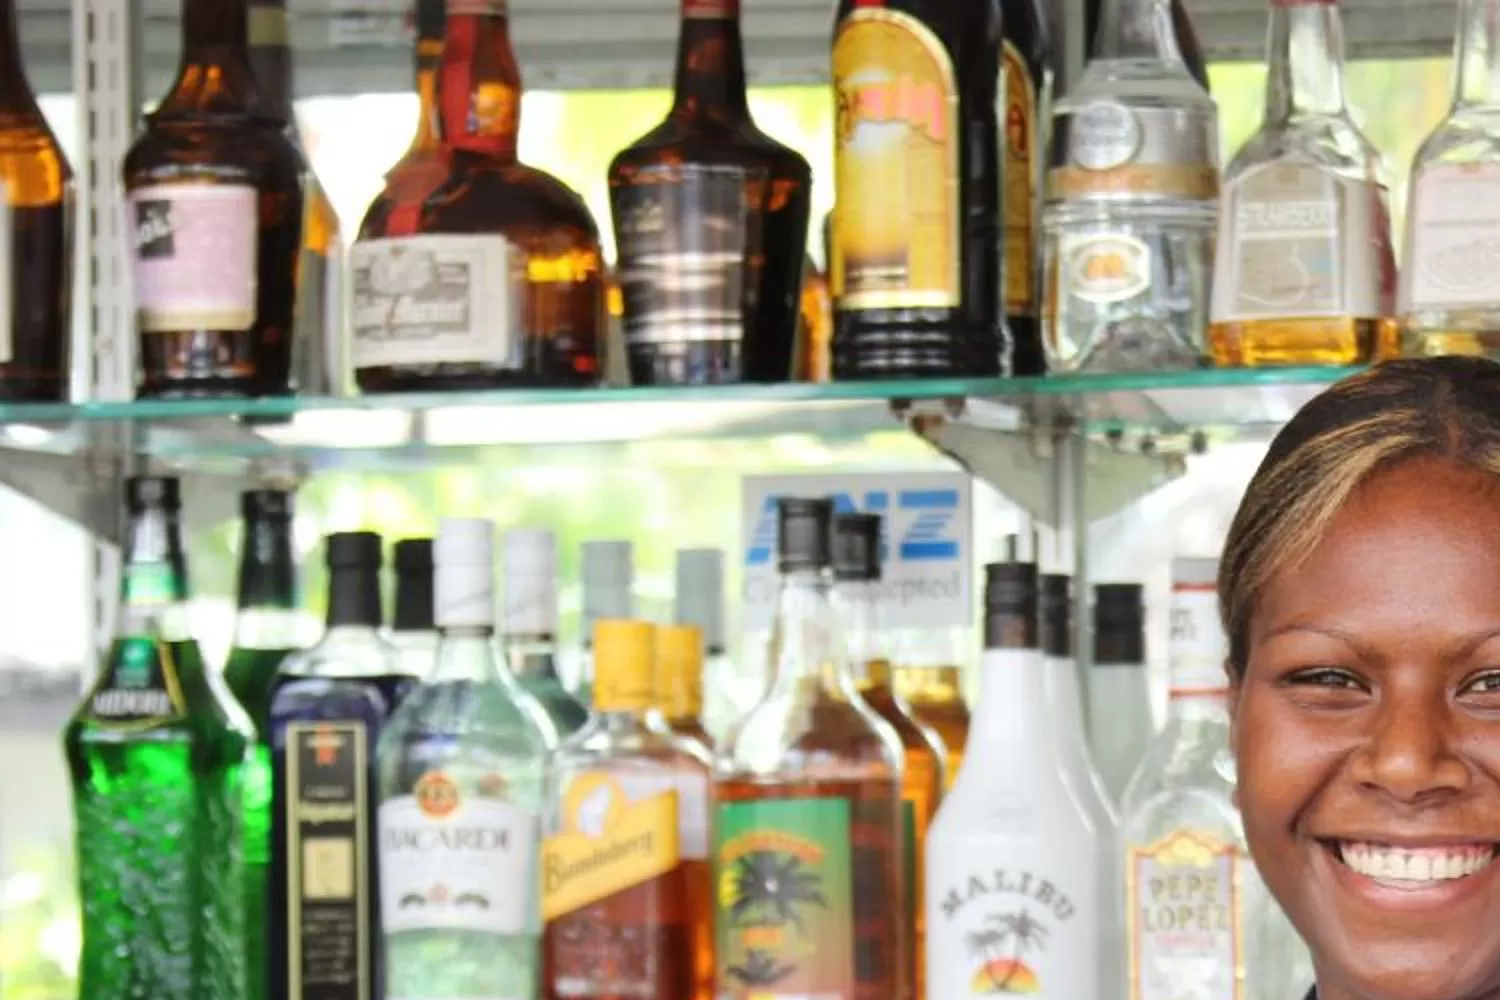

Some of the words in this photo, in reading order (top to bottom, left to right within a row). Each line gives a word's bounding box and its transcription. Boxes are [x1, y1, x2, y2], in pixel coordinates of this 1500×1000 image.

[386, 826, 512, 852] BACARDI
[938, 866, 1077, 924] MALIBU
[1150, 873, 1218, 902] PEPE
[1142, 903, 1229, 932] LOPEZ
